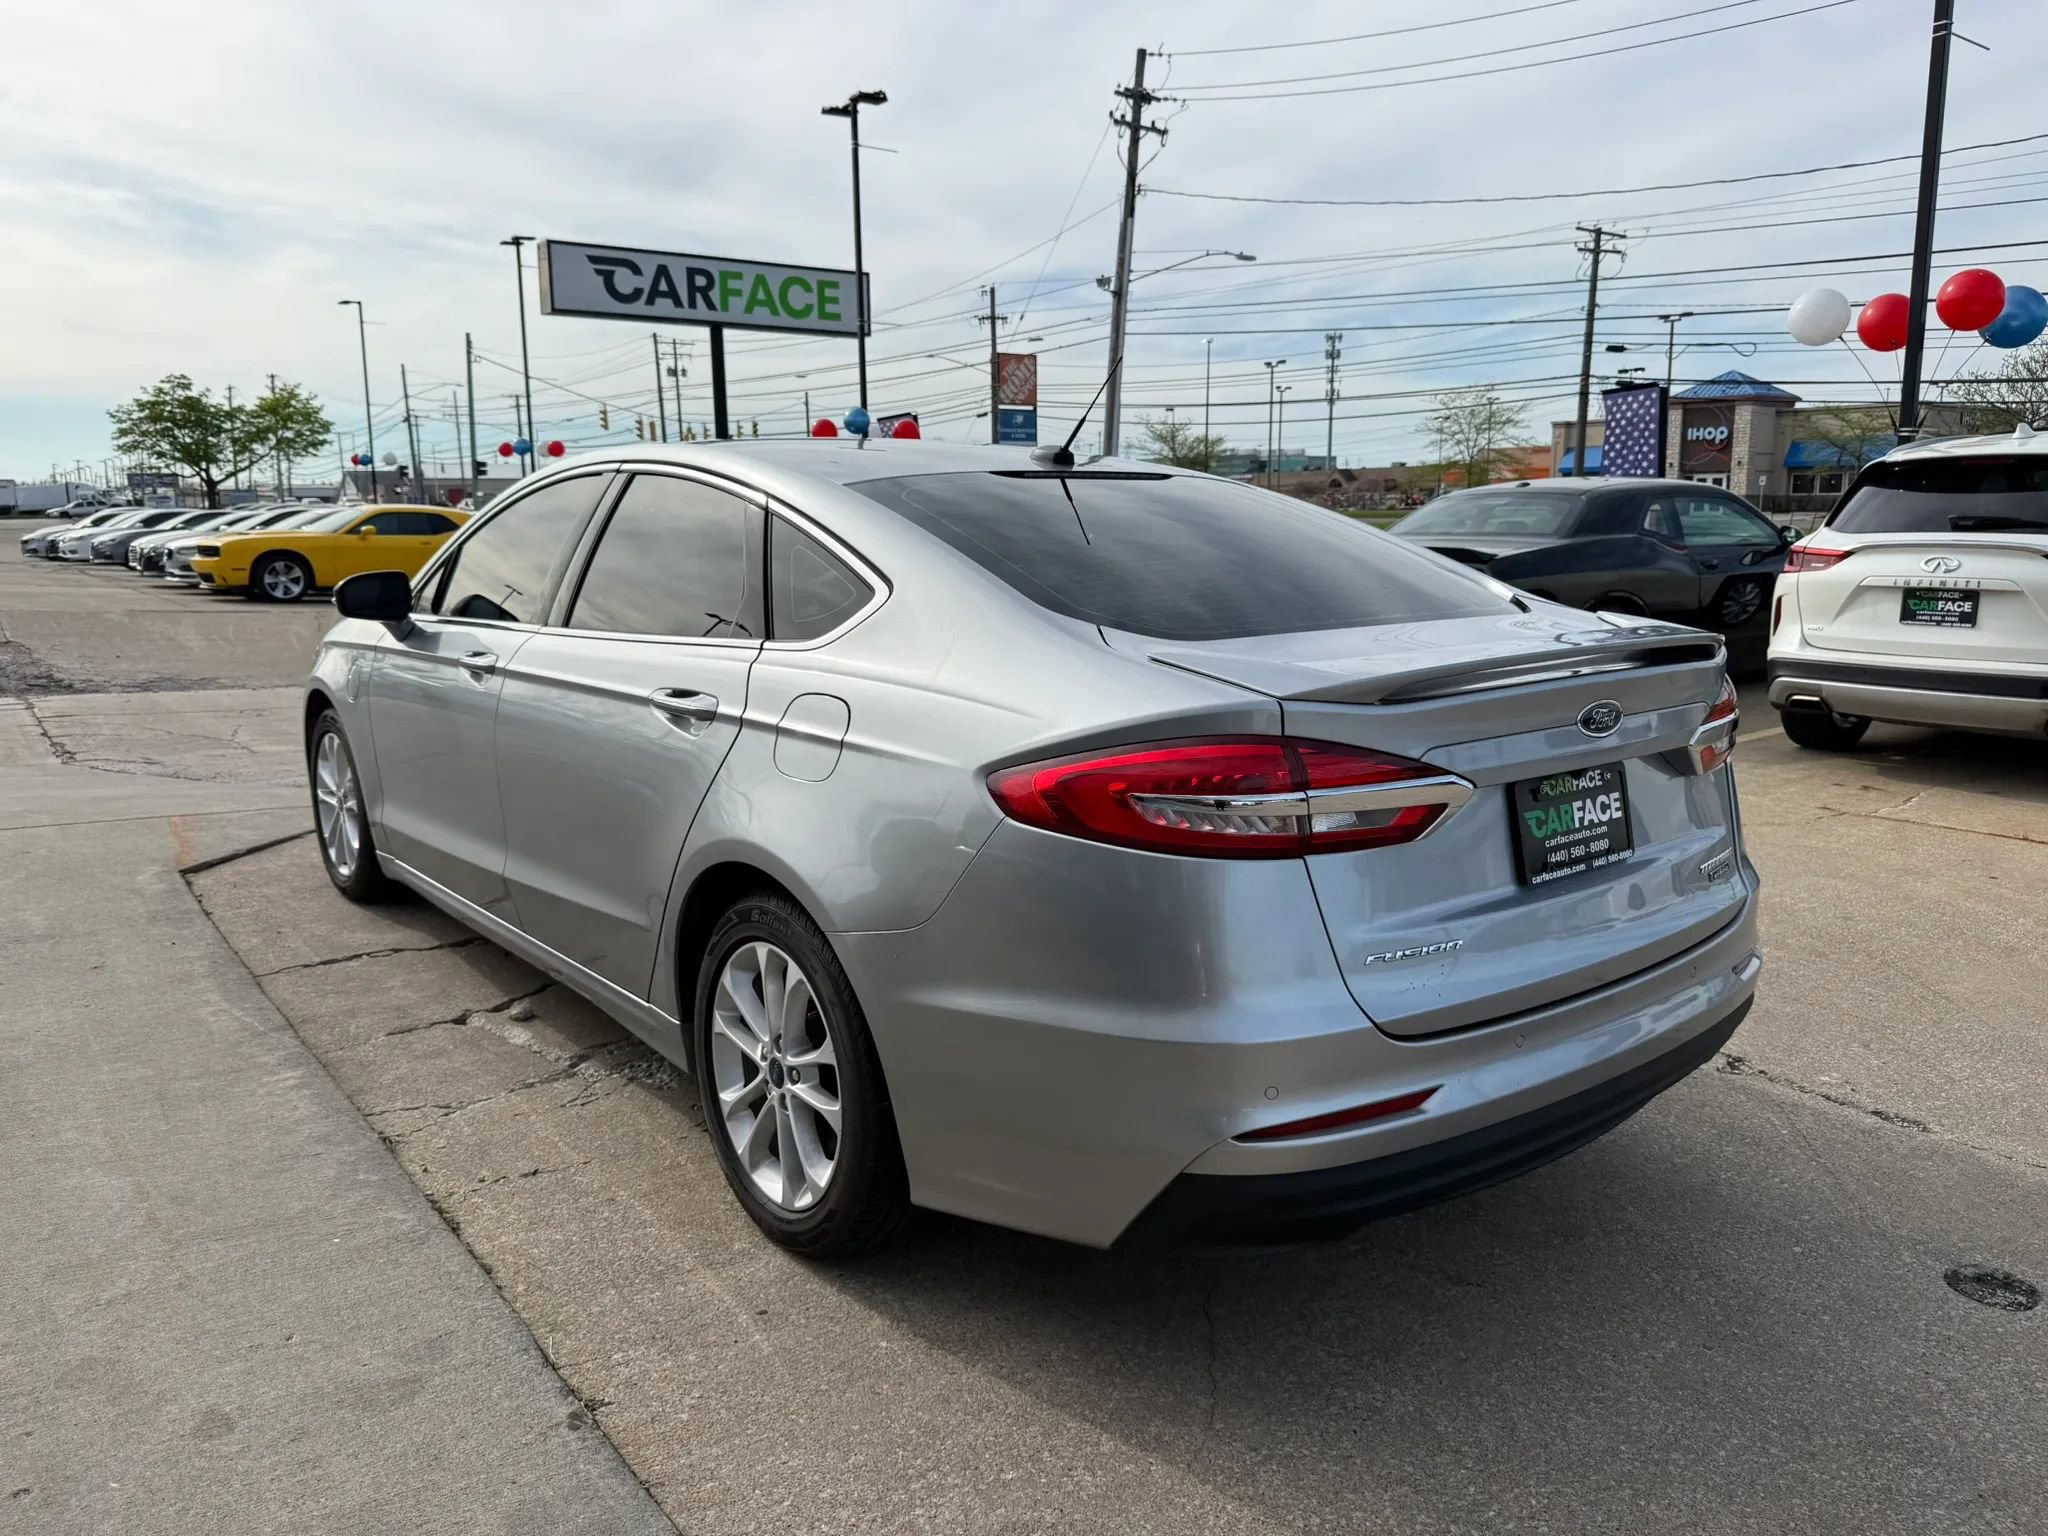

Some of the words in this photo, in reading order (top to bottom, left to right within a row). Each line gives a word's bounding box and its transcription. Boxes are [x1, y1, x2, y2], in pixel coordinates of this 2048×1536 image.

[585, 254, 842, 322] CARFACE
[1687, 426, 1728, 444] IHOP
[1893, 578, 1981, 588] INFINITI
[1907, 600, 1973, 612] CARFACE
[1590, 708, 1616, 729] Ford
[1523, 792, 1623, 838] CARFACE
[1545, 825, 1608, 848] carfaceauto.com
[1547, 849, 1569, 863] (440)
[1363, 938, 1464, 967] FUSION
